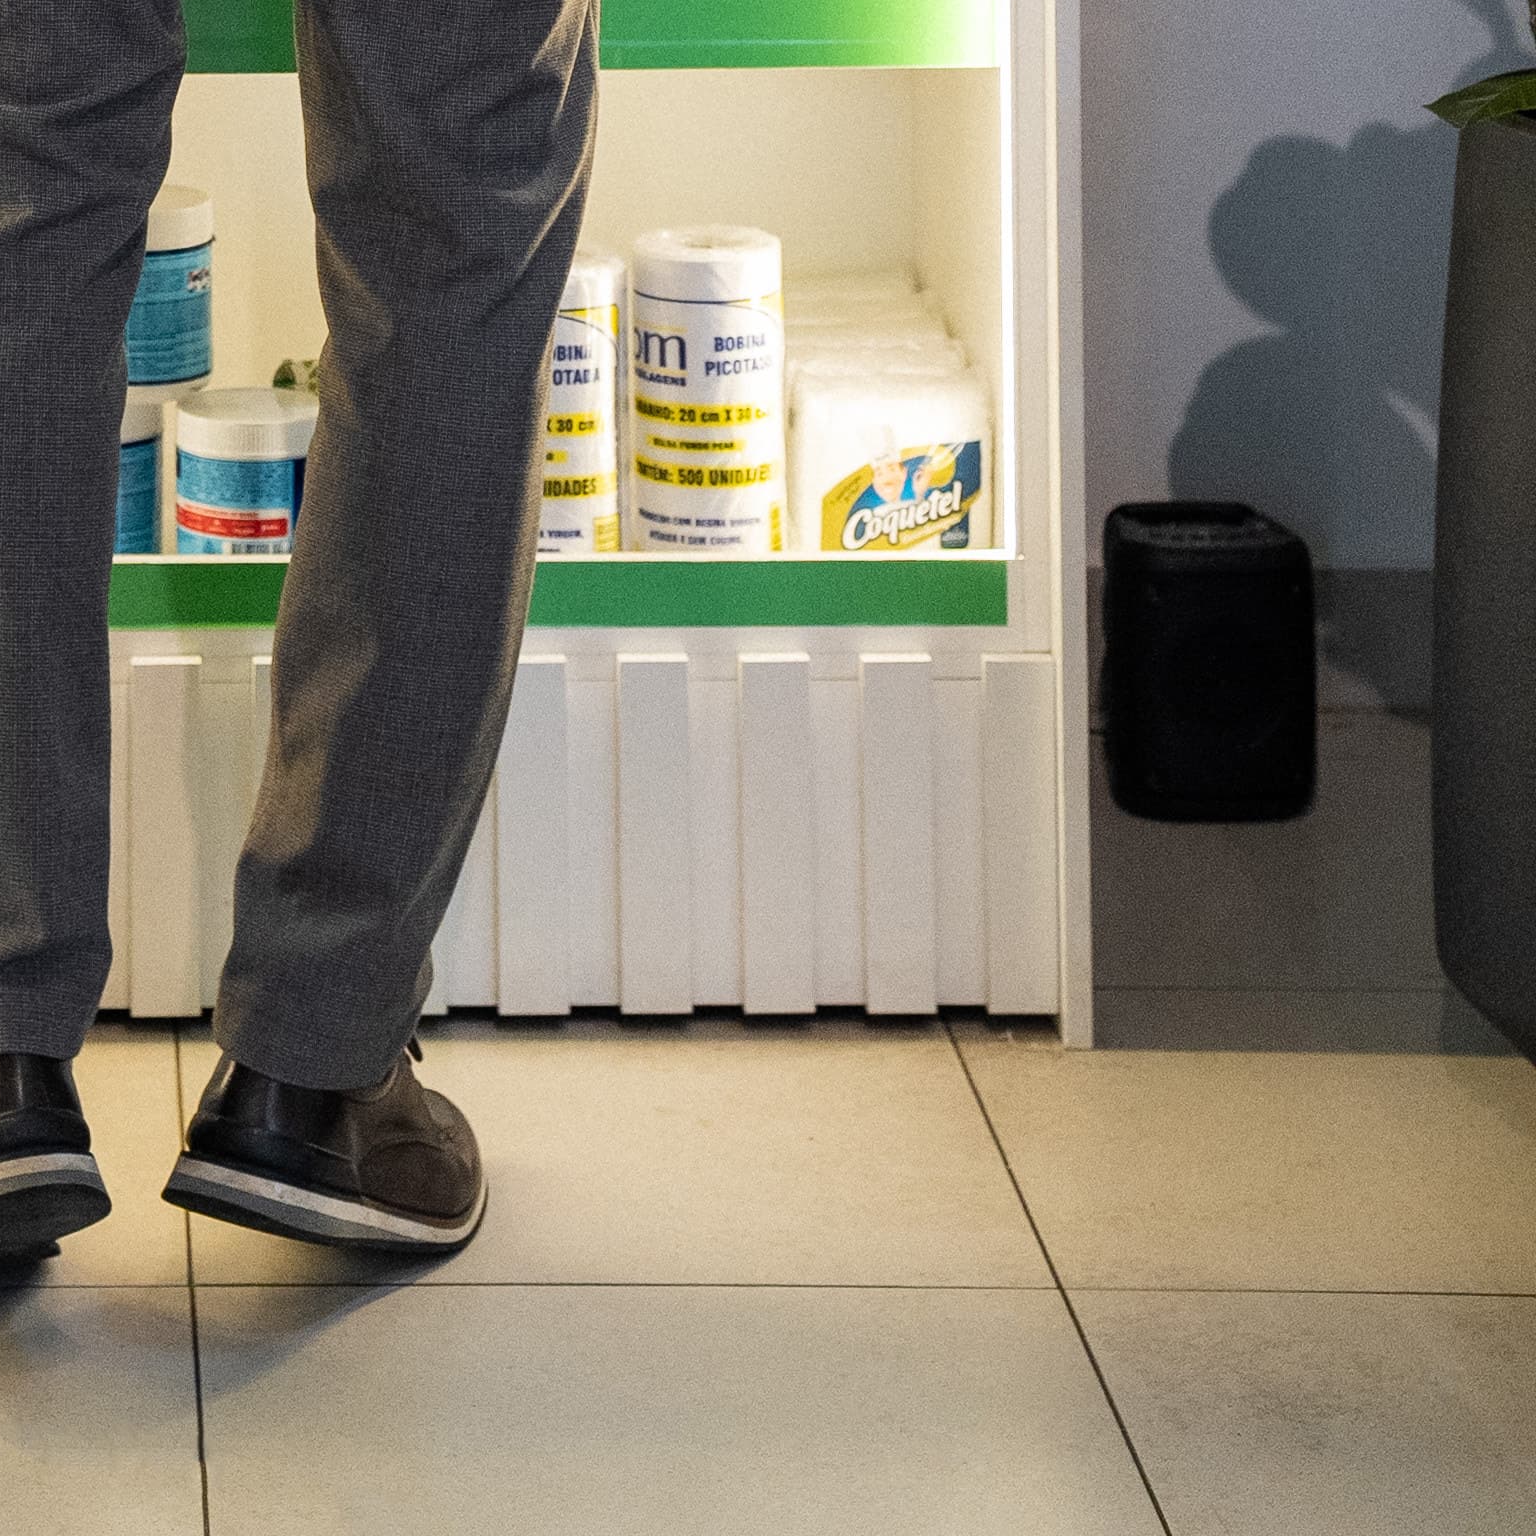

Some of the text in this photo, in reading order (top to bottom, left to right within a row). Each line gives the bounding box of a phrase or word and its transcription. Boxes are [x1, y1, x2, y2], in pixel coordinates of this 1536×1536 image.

[714, 334, 766, 353] BOBINA
[679, 408, 695, 423] 20
[700, 411, 720, 423] cm
[678, 469, 704, 487] 500
[841, 480, 963, 551] Coquetel
